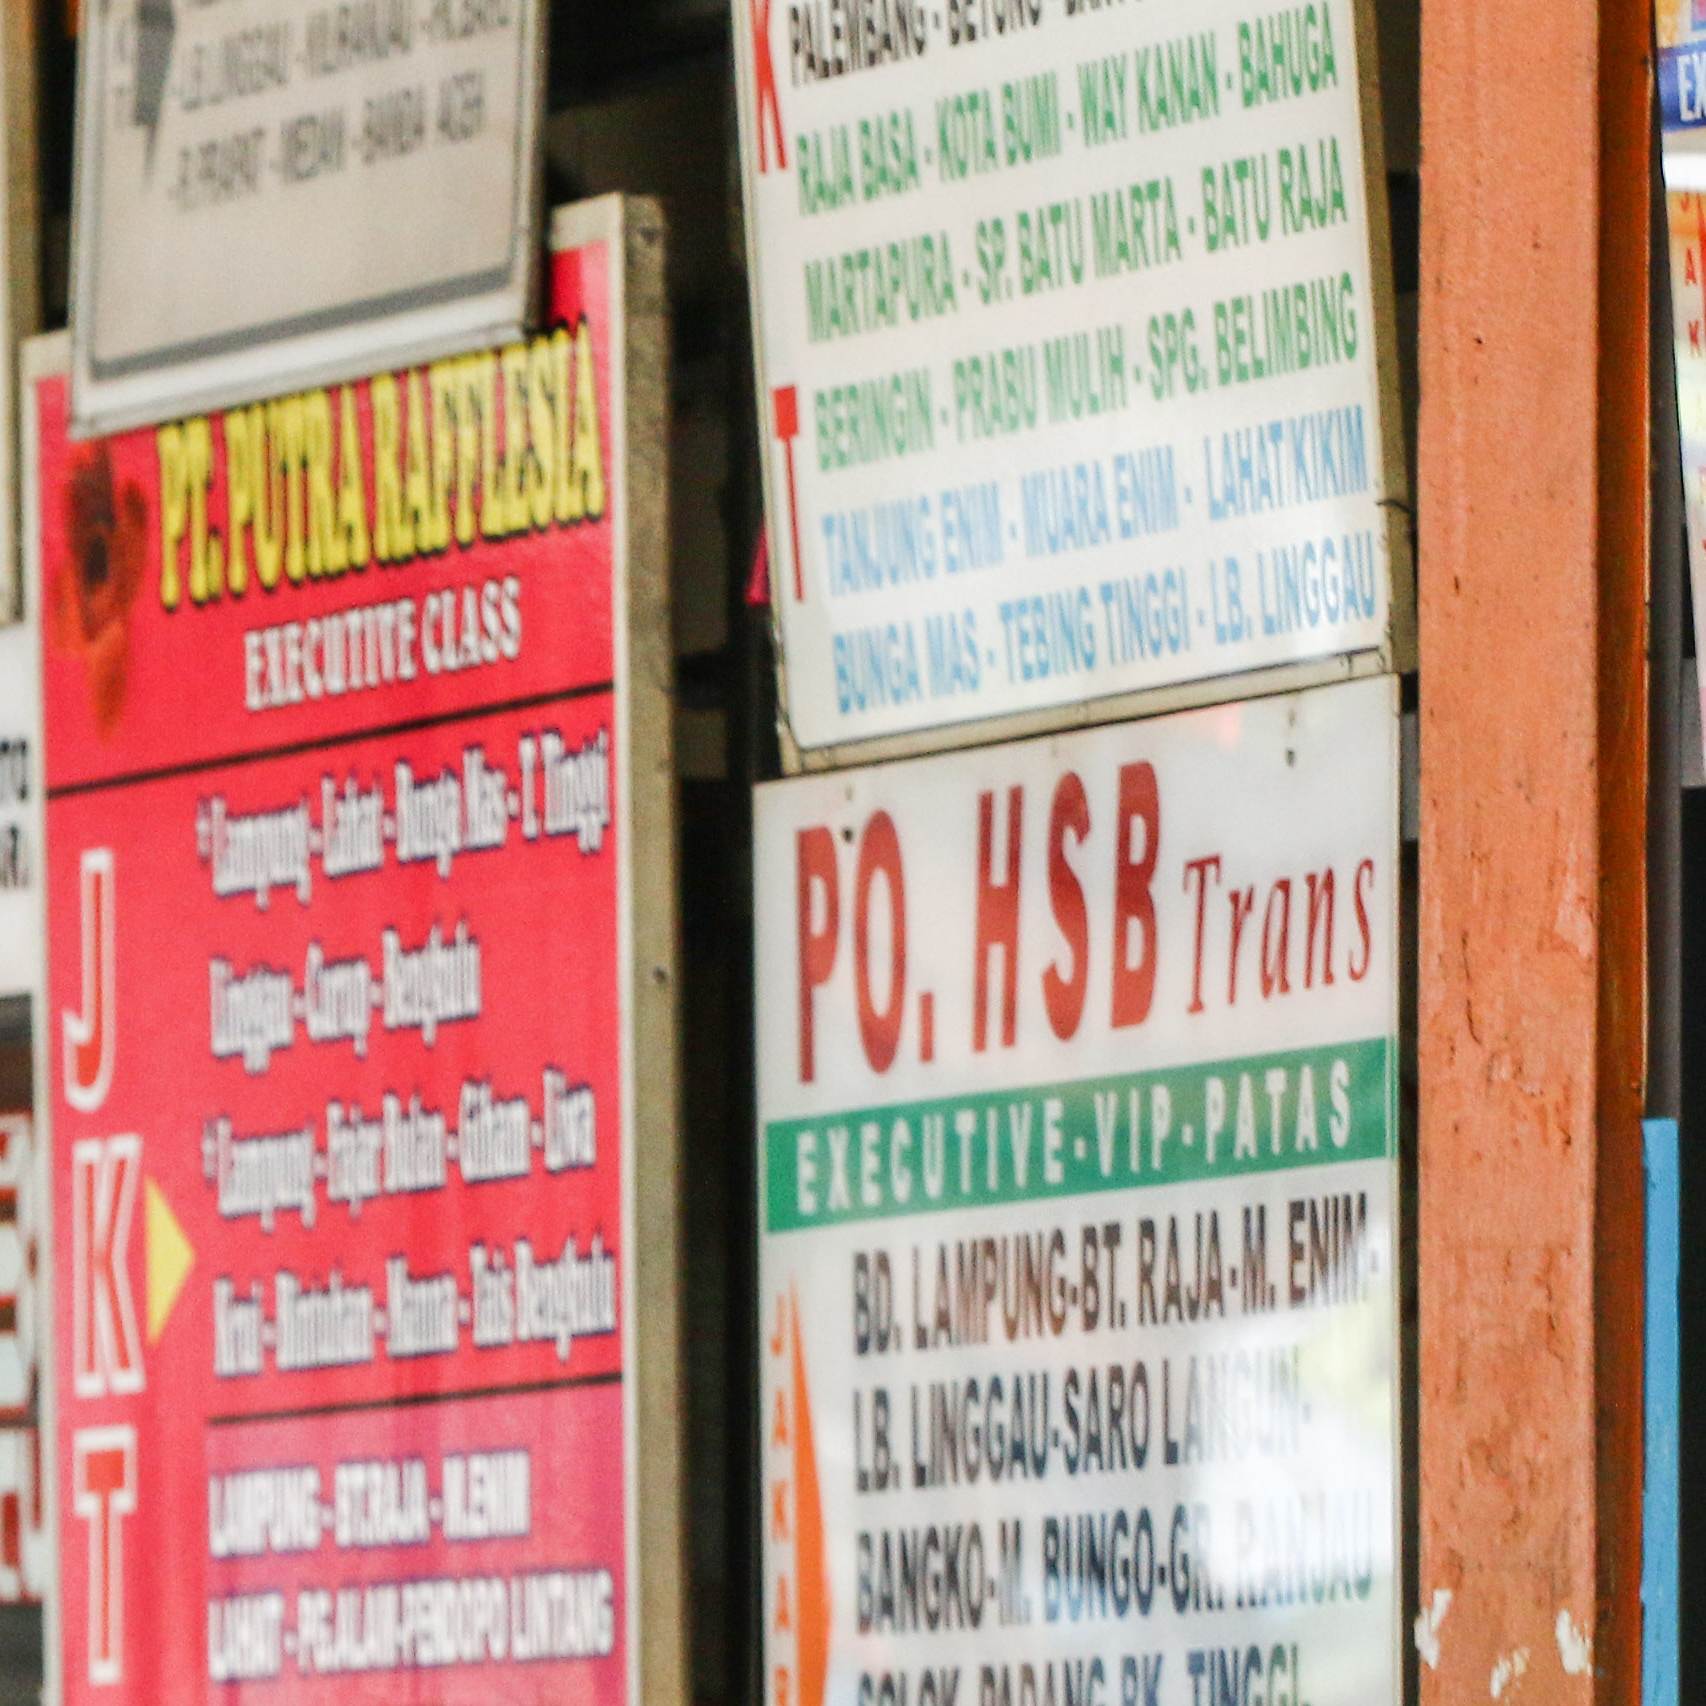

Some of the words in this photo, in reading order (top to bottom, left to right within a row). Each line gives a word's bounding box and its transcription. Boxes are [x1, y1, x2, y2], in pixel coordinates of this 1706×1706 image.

[935, 87, 999, 182] KOTA
[1001, 69, 1063, 167] BUMI
[1076, 52, 1128, 149] WAY
[1136, 29, 1220, 135] KANAN
[1237, 0, 1340, 109] BAHUGA
[803, 229, 958, 344] MARTAPURA
[1017, 196, 1084, 296] BATU
[1091, 175, 1184, 279] MARTA
[1201, 152, 1271, 255] BATU
[1277, 134, 1349, 237] RAJA
[224, 386, 371, 599] PUTRA
[372, 318, 606, 570] RAFFLESIA
[813, 365, 935, 476] BERINGIN
[952, 343, 1038, 445] PRABU
[1214, 270, 1359, 388] BELIMBING
[822, 492, 936, 598] TANJUNG
[940, 479, 1006, 575] ENIM
[1020, 458, 1111, 559] MUARA
[1113, 442, 1180, 540] ENIM
[243, 596, 418, 713] EXECUTIVE
[421, 573, 522, 679] CLASS
[833, 619, 924, 717] BUNGA
[926, 606, 982, 698] MAS
[999, 583, 1098, 685] TEBING
[1099, 565, 1192, 667] TINGGI
[1256, 529, 1377, 638] LINGGAU
[794, 808, 935, 1085] PO.
[971, 758, 1163, 1055] HSB
[1183, 852, 1376, 1016] Trans
